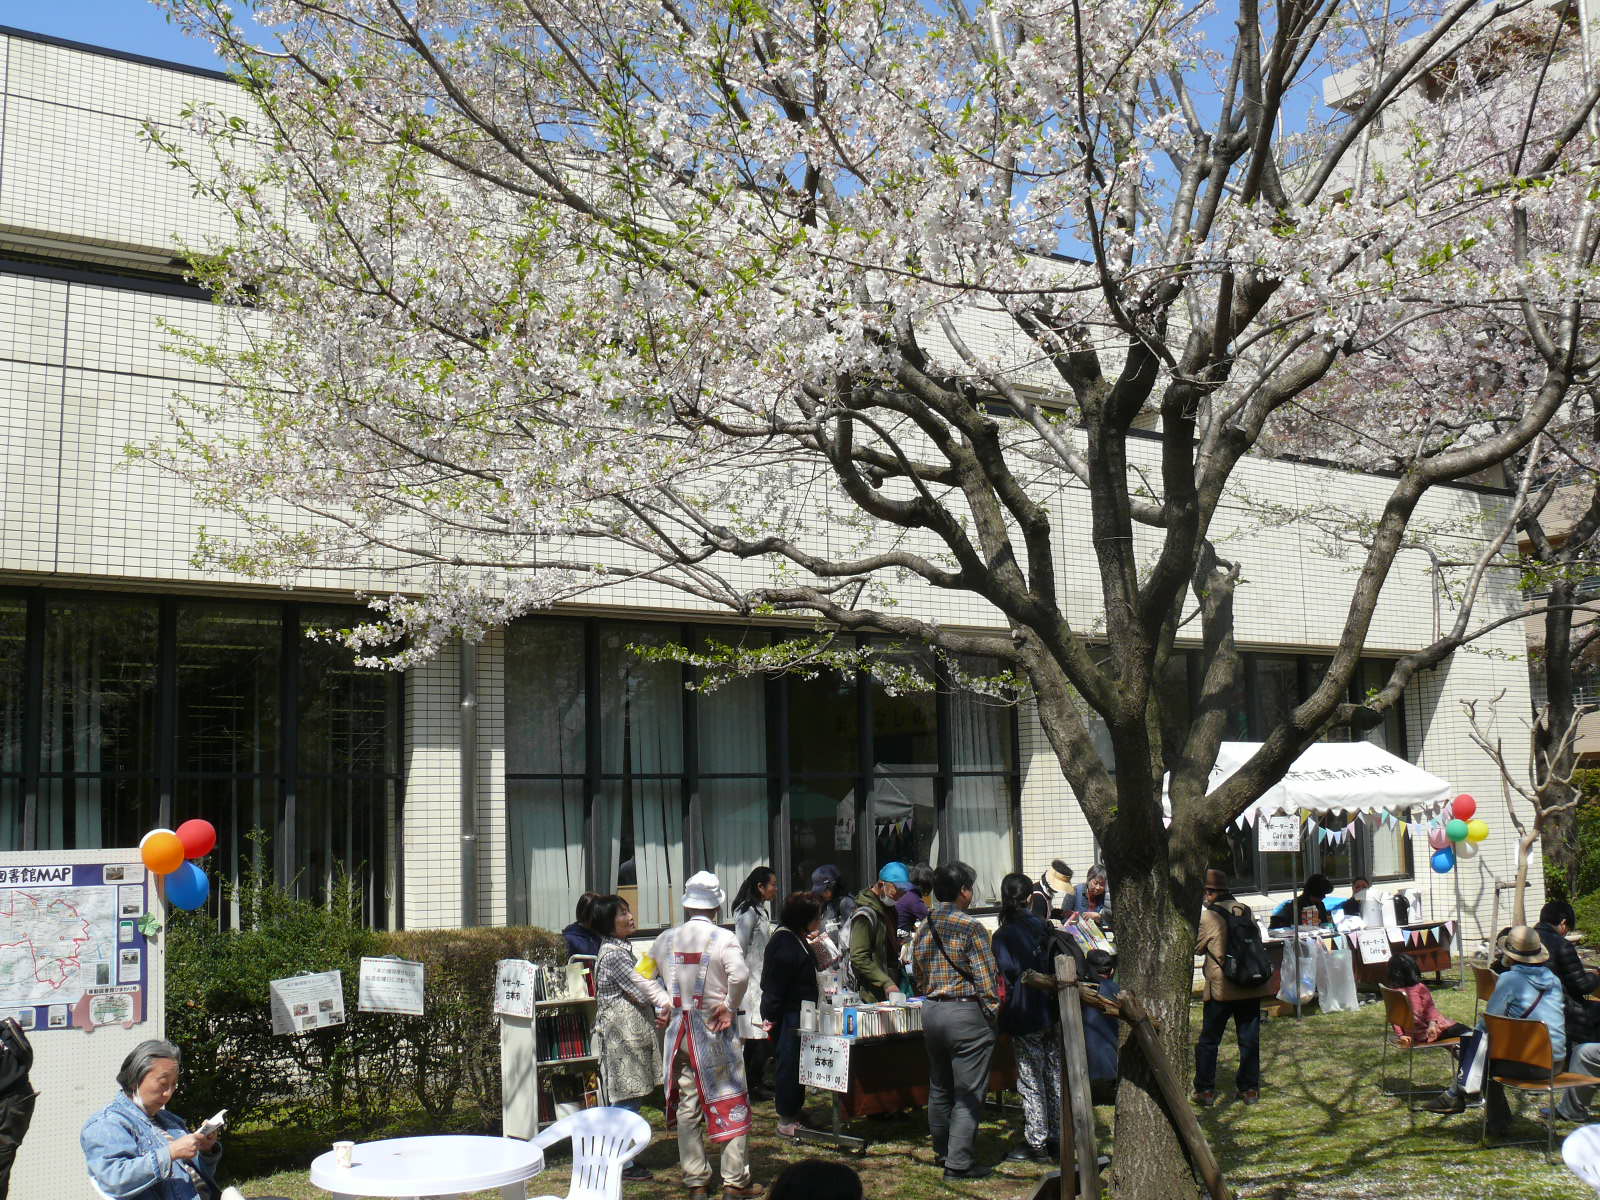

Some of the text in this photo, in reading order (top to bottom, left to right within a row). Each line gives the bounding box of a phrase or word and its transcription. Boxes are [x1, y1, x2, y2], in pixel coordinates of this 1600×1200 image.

[810, 1044, 840, 1055] サポーター
[815, 1057, 833, 1068] 古本市
